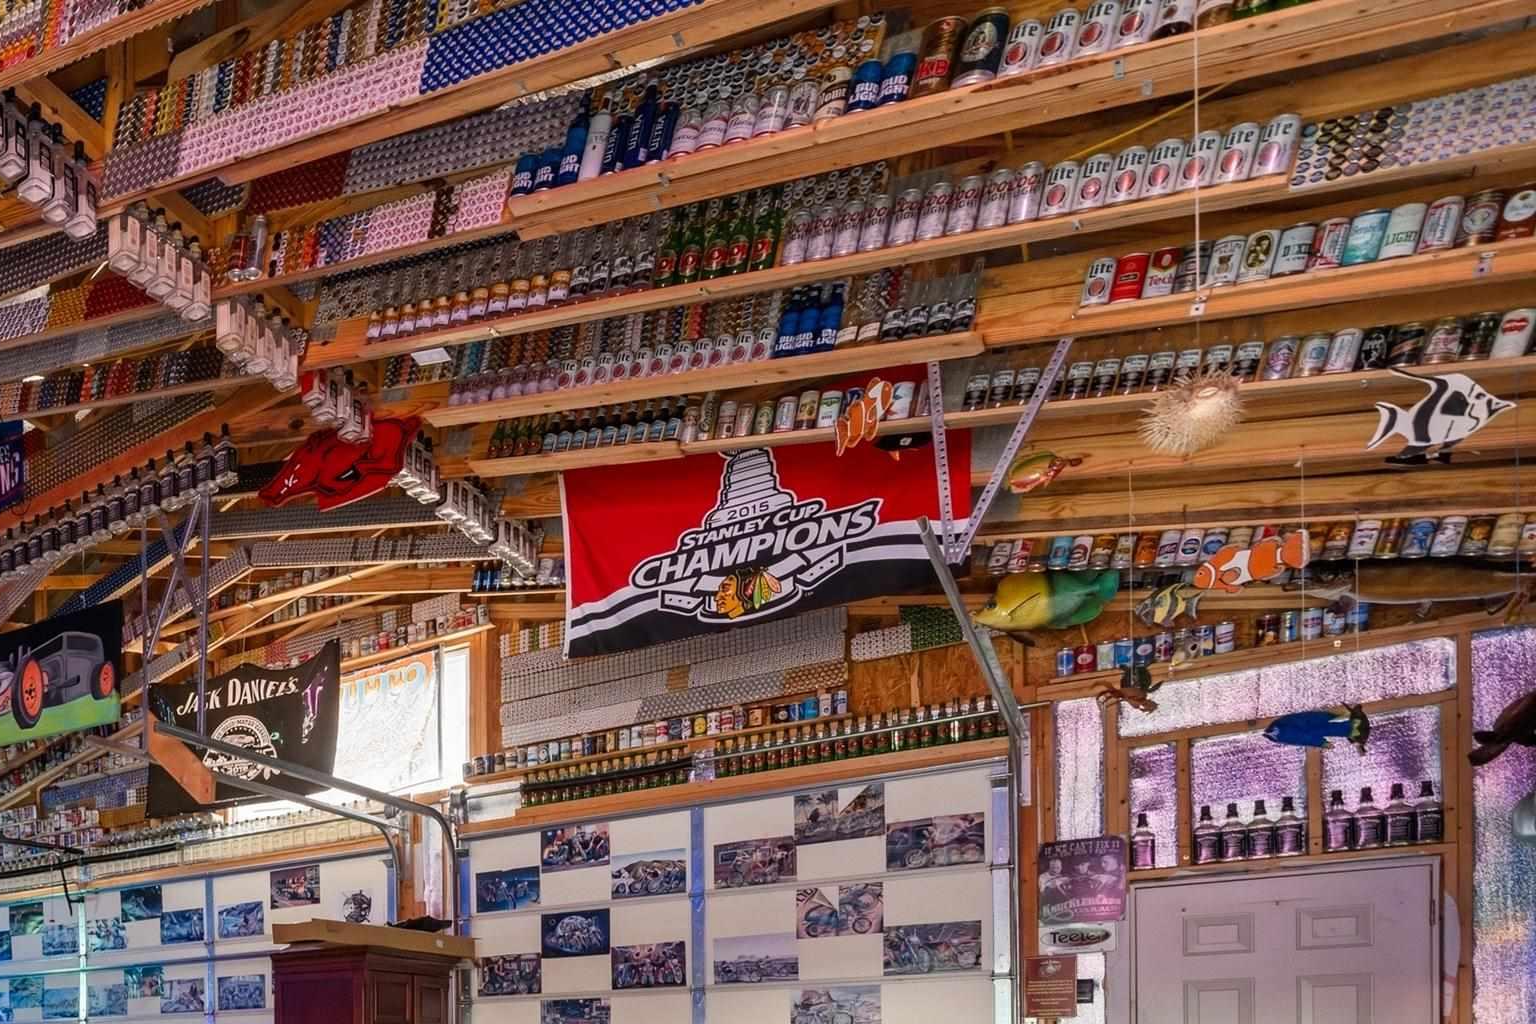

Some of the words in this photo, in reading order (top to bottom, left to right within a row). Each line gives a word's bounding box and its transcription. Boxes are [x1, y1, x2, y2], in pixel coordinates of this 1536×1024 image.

[878, 85, 910, 100] IGHT
[681, 515, 772, 550] STANLEY
[772, 503, 821, 526] CUP
[727, 500, 770, 521] 2015
[634, 503, 875, 588] CHAMPIONS
